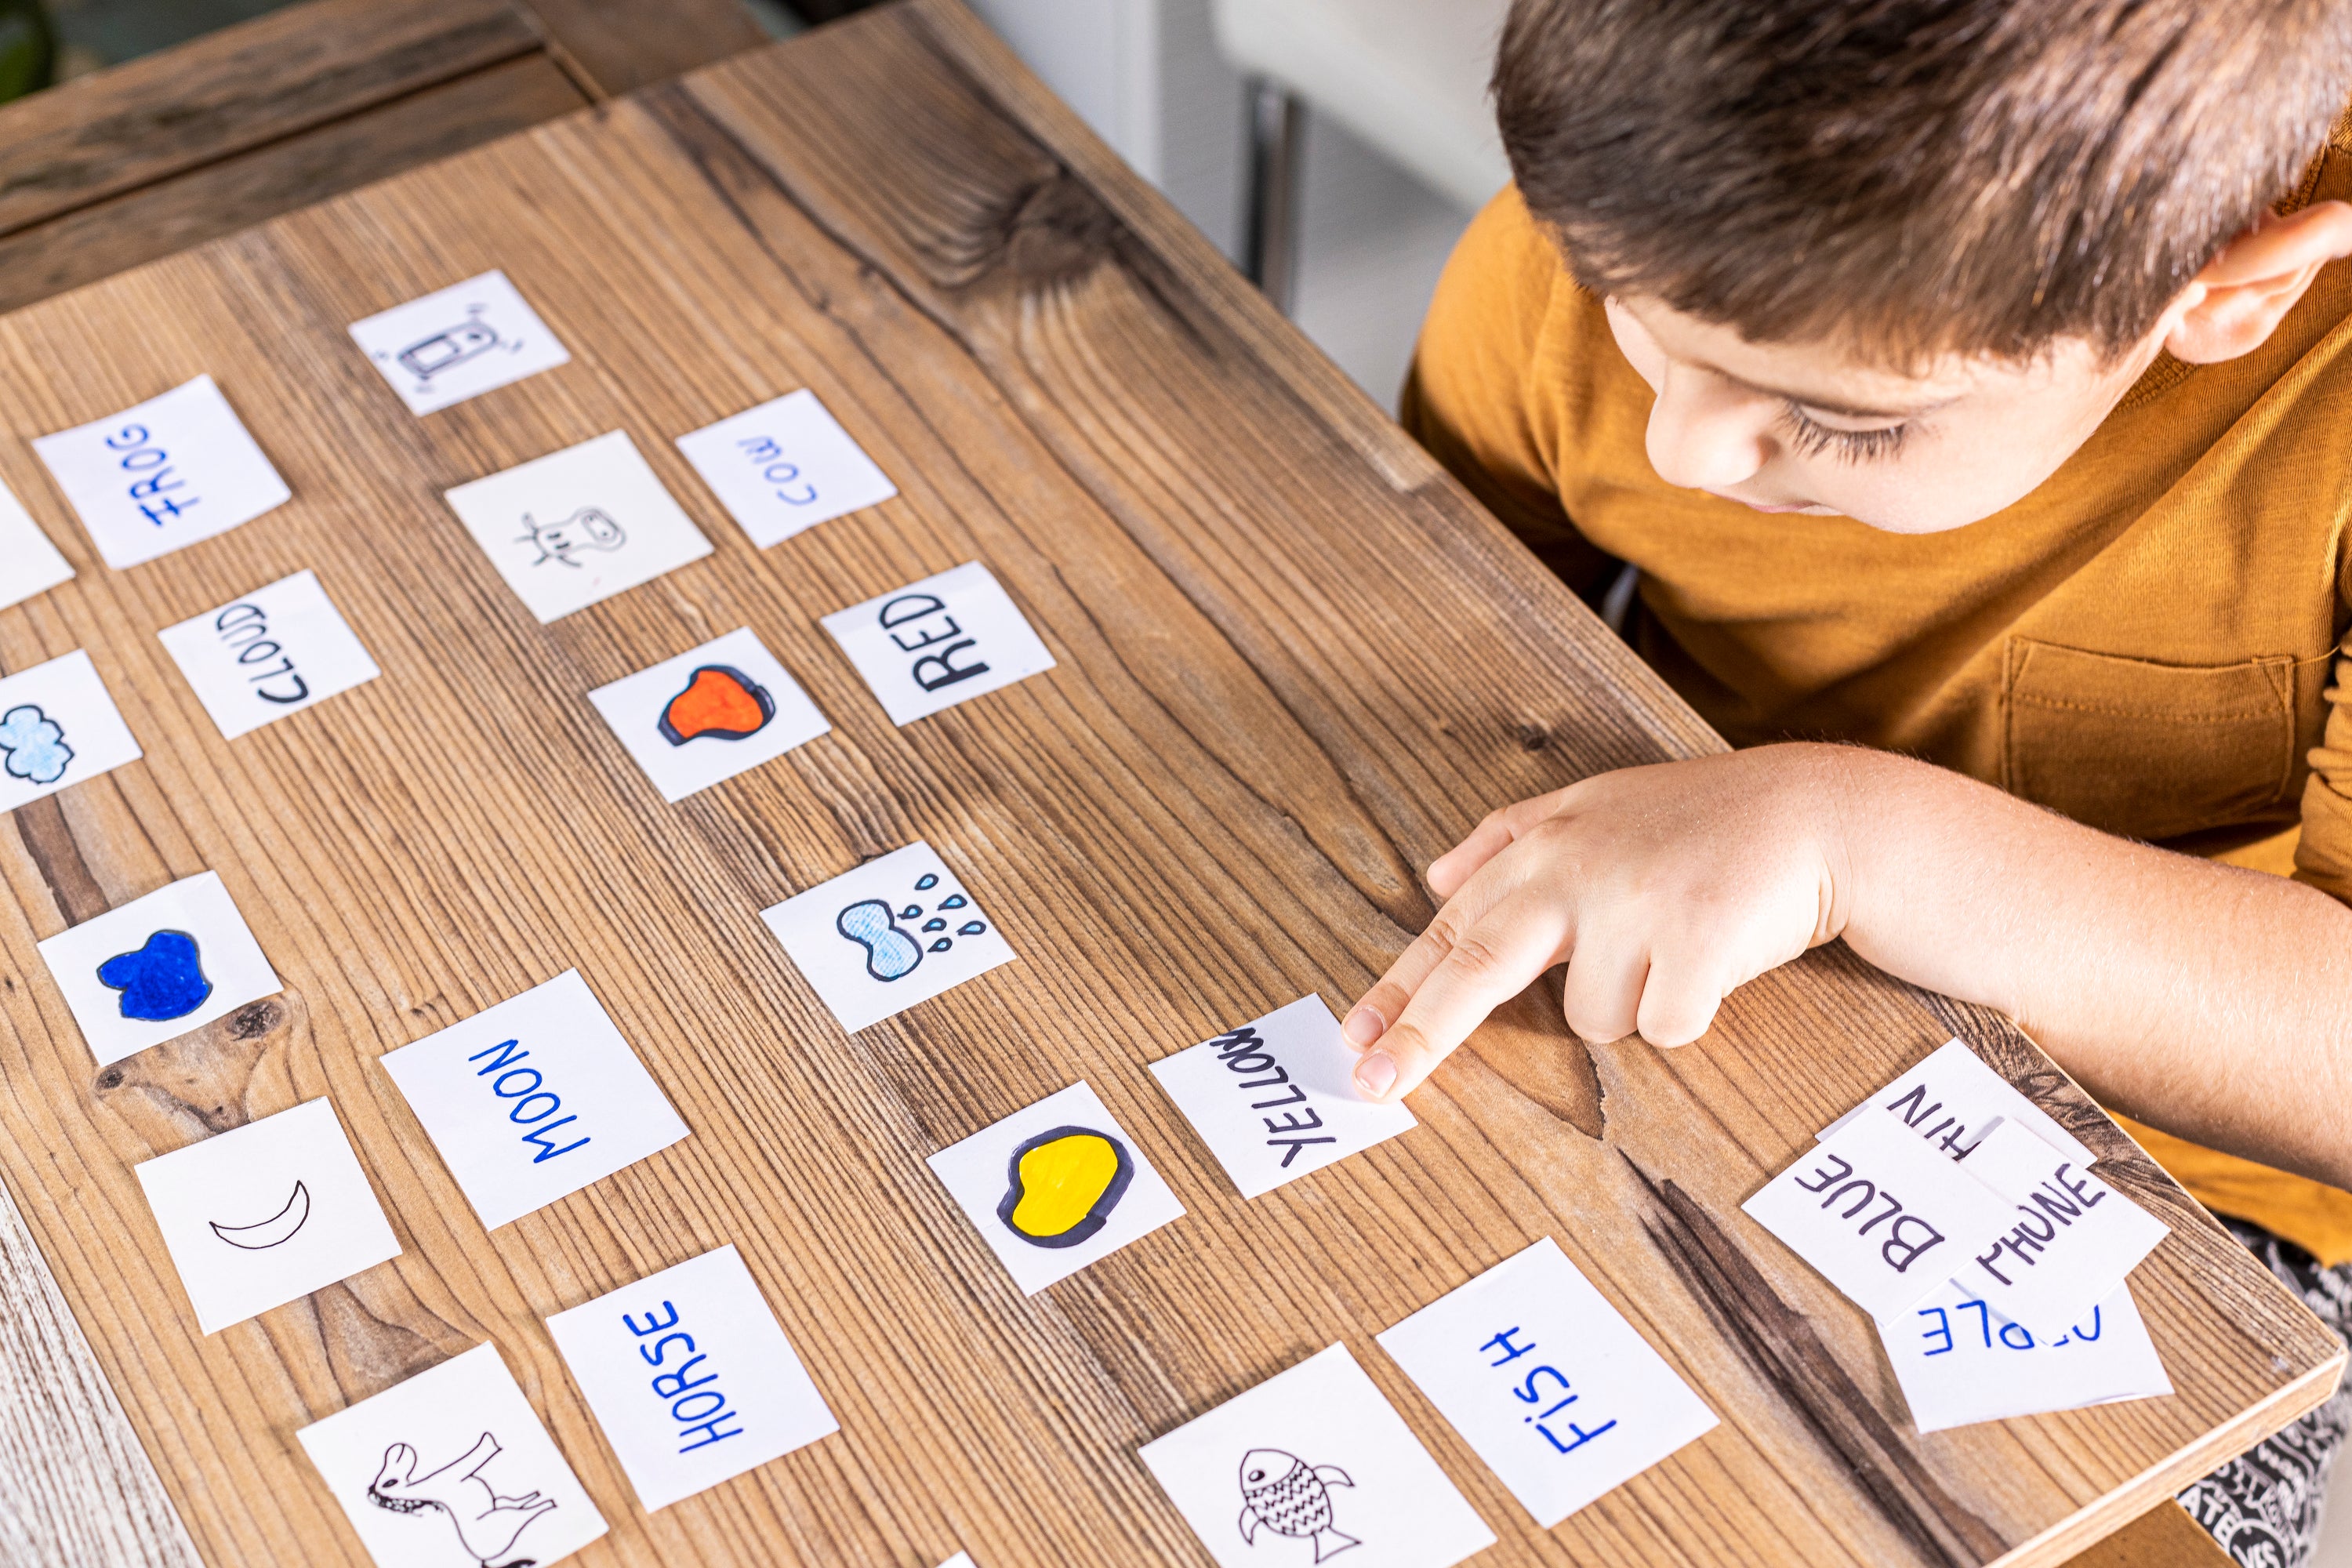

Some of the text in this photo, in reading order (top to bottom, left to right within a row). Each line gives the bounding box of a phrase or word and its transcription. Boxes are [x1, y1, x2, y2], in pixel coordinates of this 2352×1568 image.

[104, 423, 201, 526] FROG
[215, 604, 308, 703] CLOUD
[879, 594, 989, 691] RED
[469, 1040, 590, 1163] MOON
[1208, 1027, 1337, 1167] YELLOW
[1795, 1154, 1945, 1272] BLUE
[622, 1301, 743, 1454] HORSE
